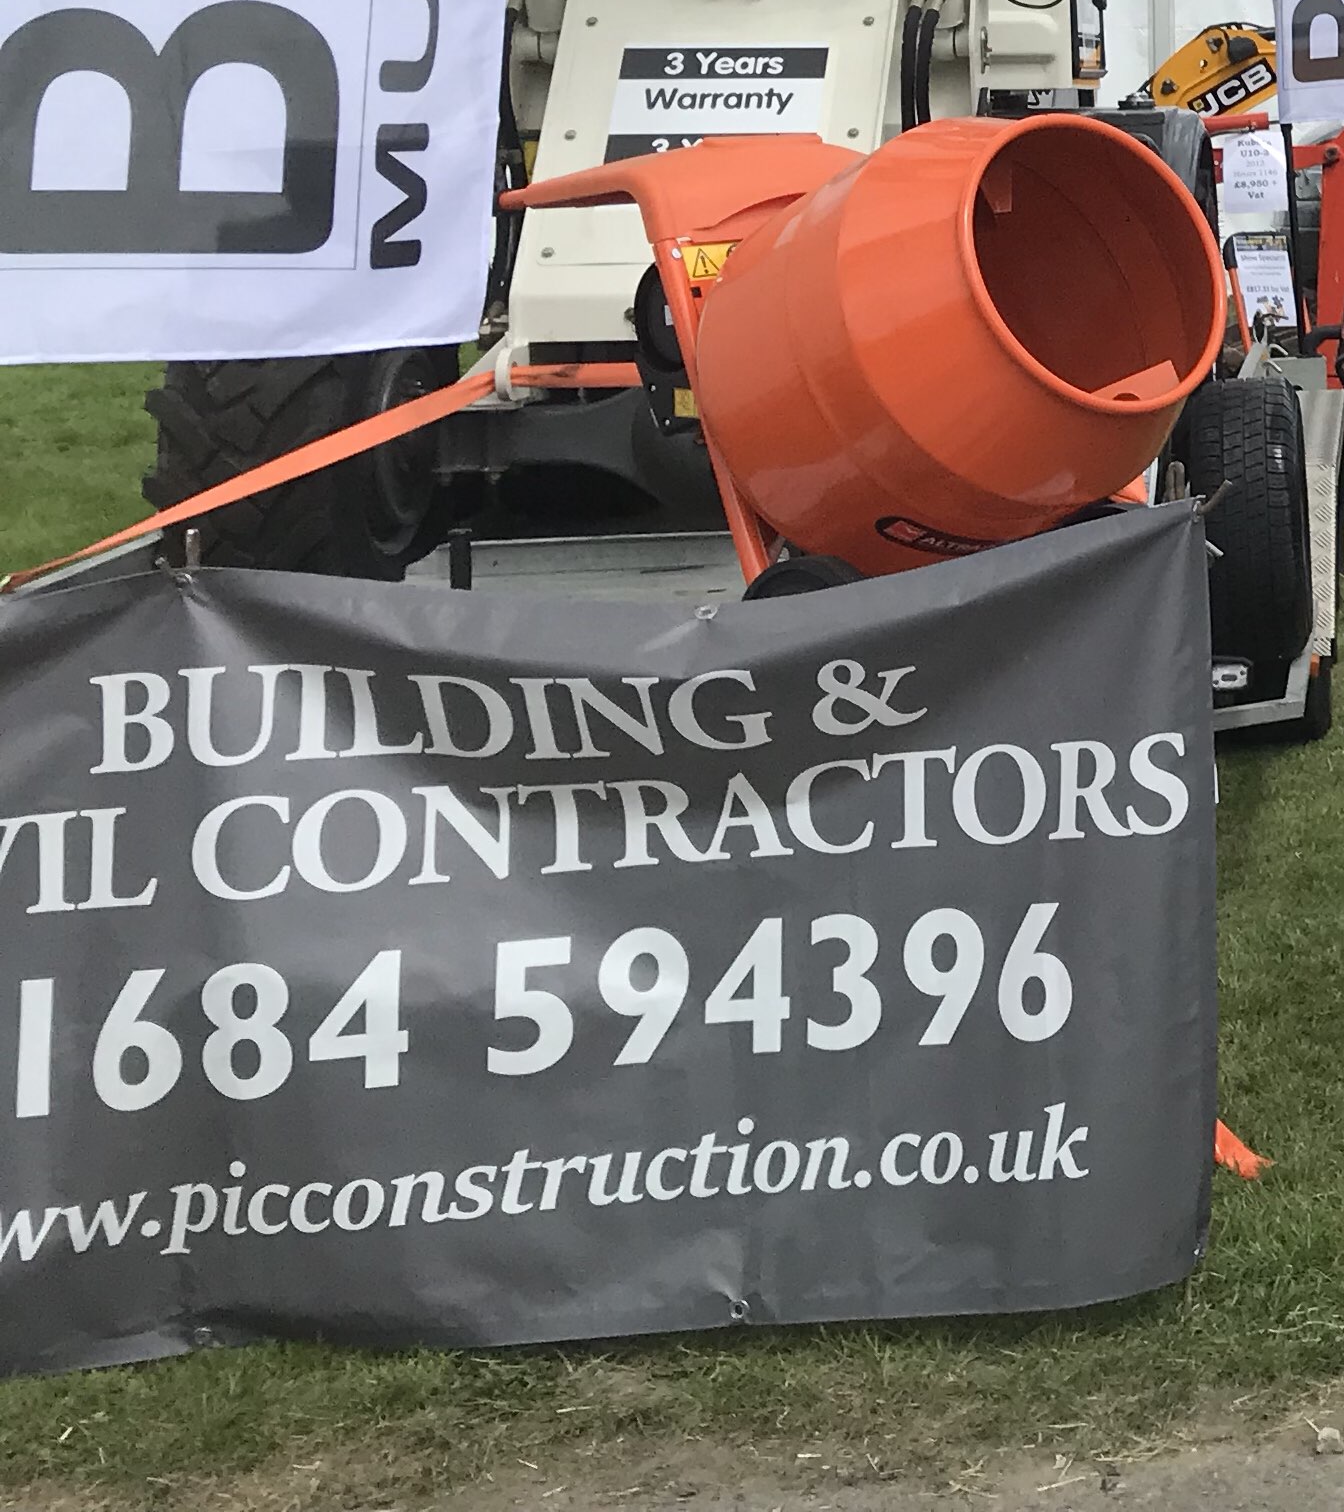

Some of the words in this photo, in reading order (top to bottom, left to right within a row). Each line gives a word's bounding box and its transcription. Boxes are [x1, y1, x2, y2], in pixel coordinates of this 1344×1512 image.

[664, 52, 684, 75] 3
[696, 52, 784, 75] Years
[1191, 62, 1273, 117] JCB
[645, 88, 793, 115] Warranty
[1237, 138, 1272, 147] Kuba
[90, 662, 774, 774] BUILDING
[811, 658, 927, 737] &
[191, 732, 1191, 901] CONTRACTORS
[16, 949, 409, 1117] 1684
[485, 902, 1074, 1078] 594396
